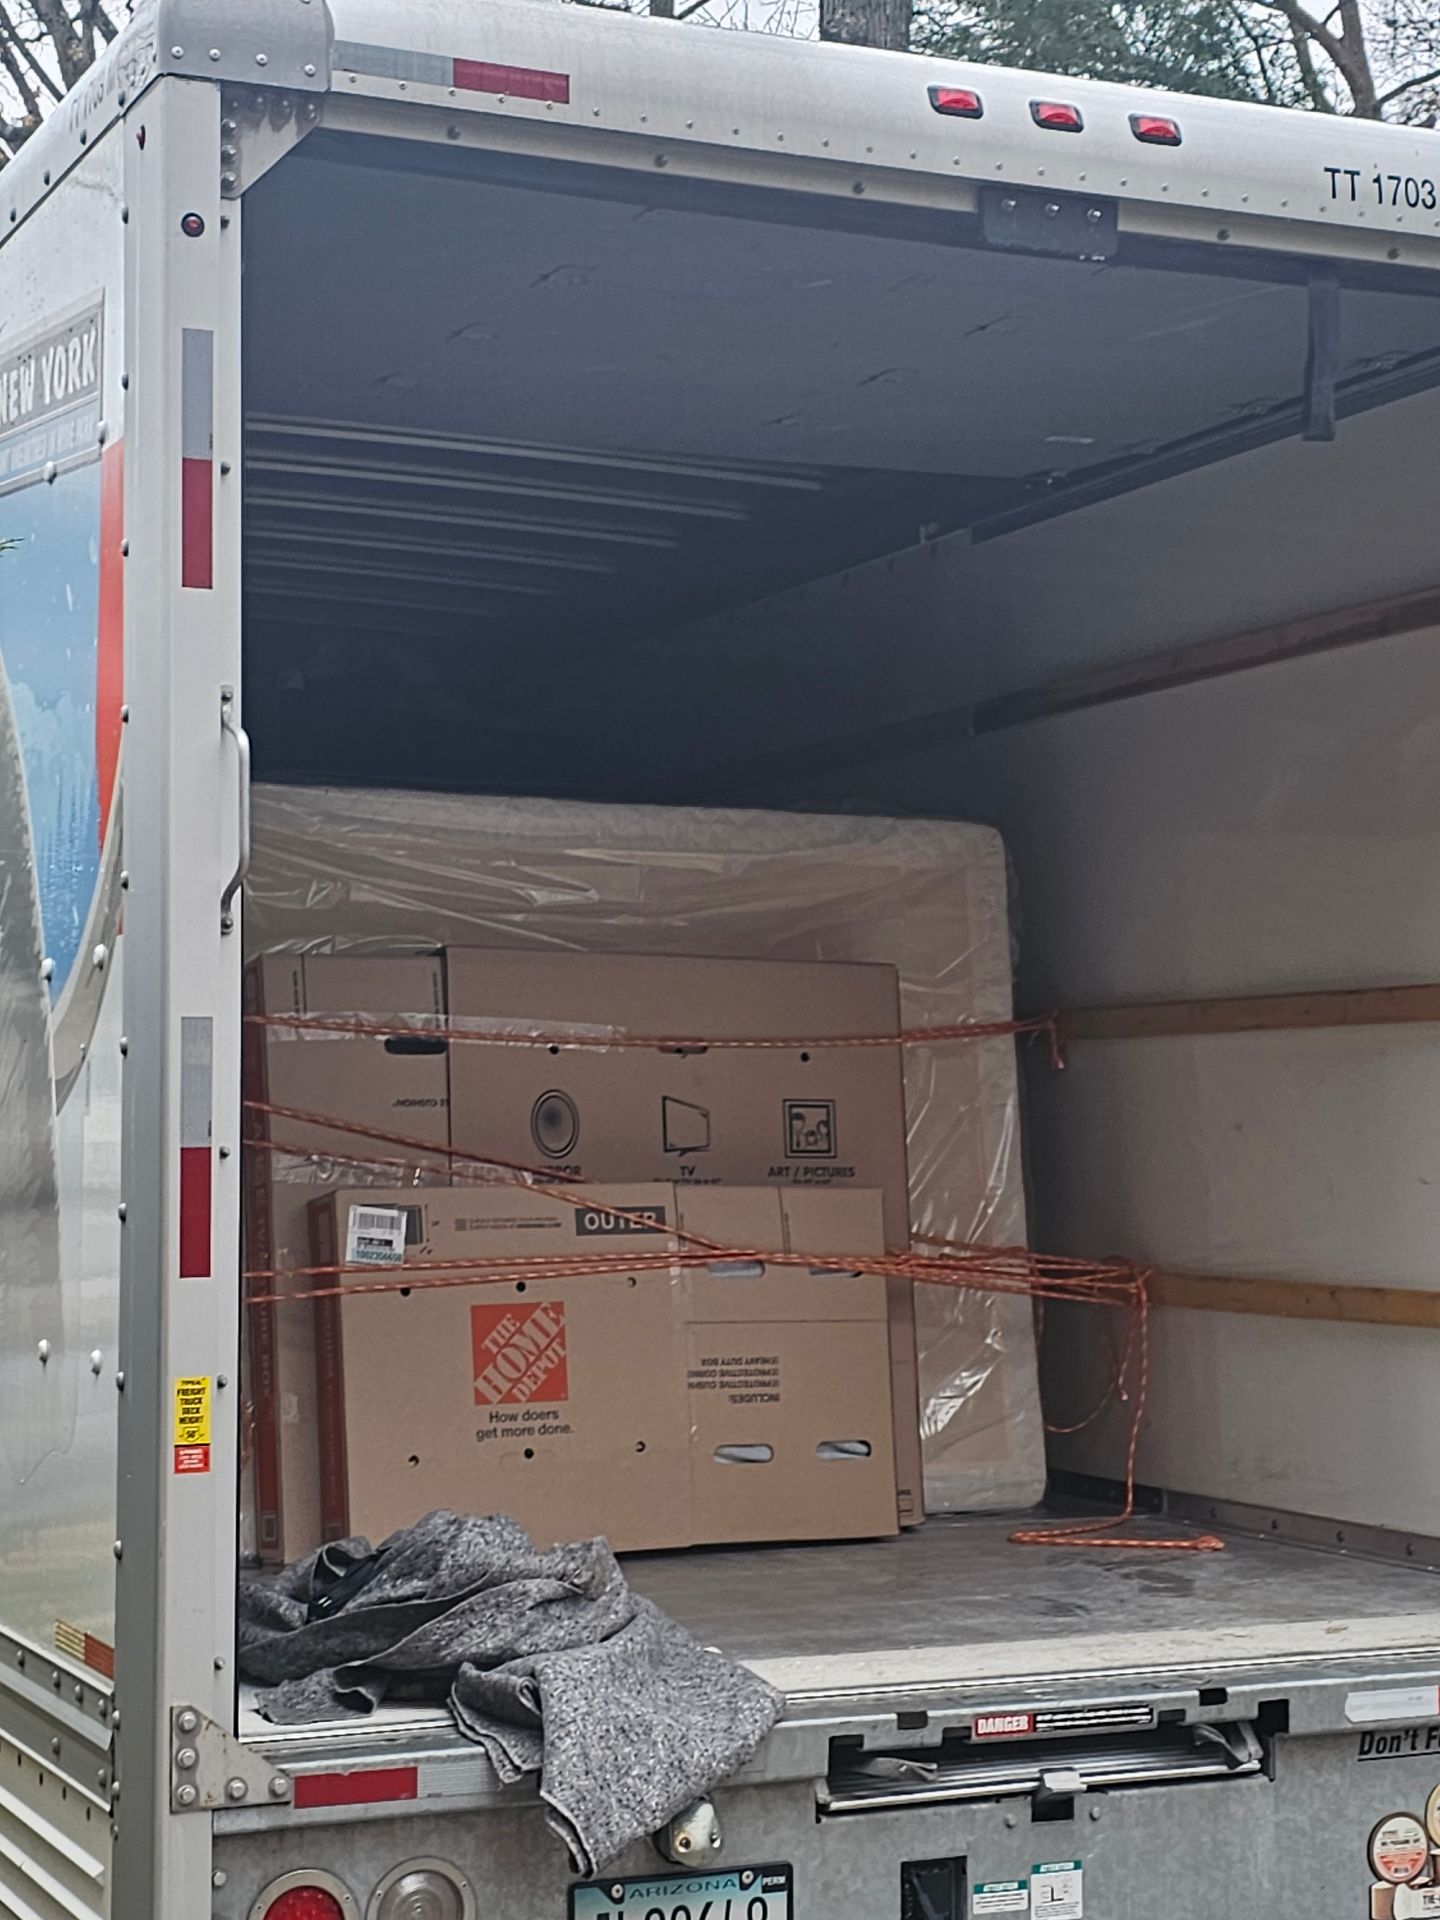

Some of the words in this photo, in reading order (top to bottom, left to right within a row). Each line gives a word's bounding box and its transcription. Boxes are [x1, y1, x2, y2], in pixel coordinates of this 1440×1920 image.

[1324, 166, 1361, 201] TT
[1372, 173, 1437, 210] 1703
[0, 359, 35, 424] NEW
[42, 326, 96, 405] YORK
[680, 1165, 697, 1177] TV
[768, 1166, 791, 1177] ART
[803, 1166, 856, 1178] PICTURES
[584, 1211, 657, 1231] OUTER
[481, 1313, 520, 1354] THE
[474, 1302, 565, 1405] HOME
[511, 1338, 567, 1403] DEPOT
[489, 1411, 519, 1424] How
[522, 1408, 559, 1421] doers
[476, 1427, 498, 1442] get
[501, 1427, 535, 1438] more
[538, 1423, 575, 1437] done.
[977, 1715, 1029, 1735] DANGER
[1358, 1729, 1419, 1756] Don't
[629, 1878, 737, 1900] ARIZONA
